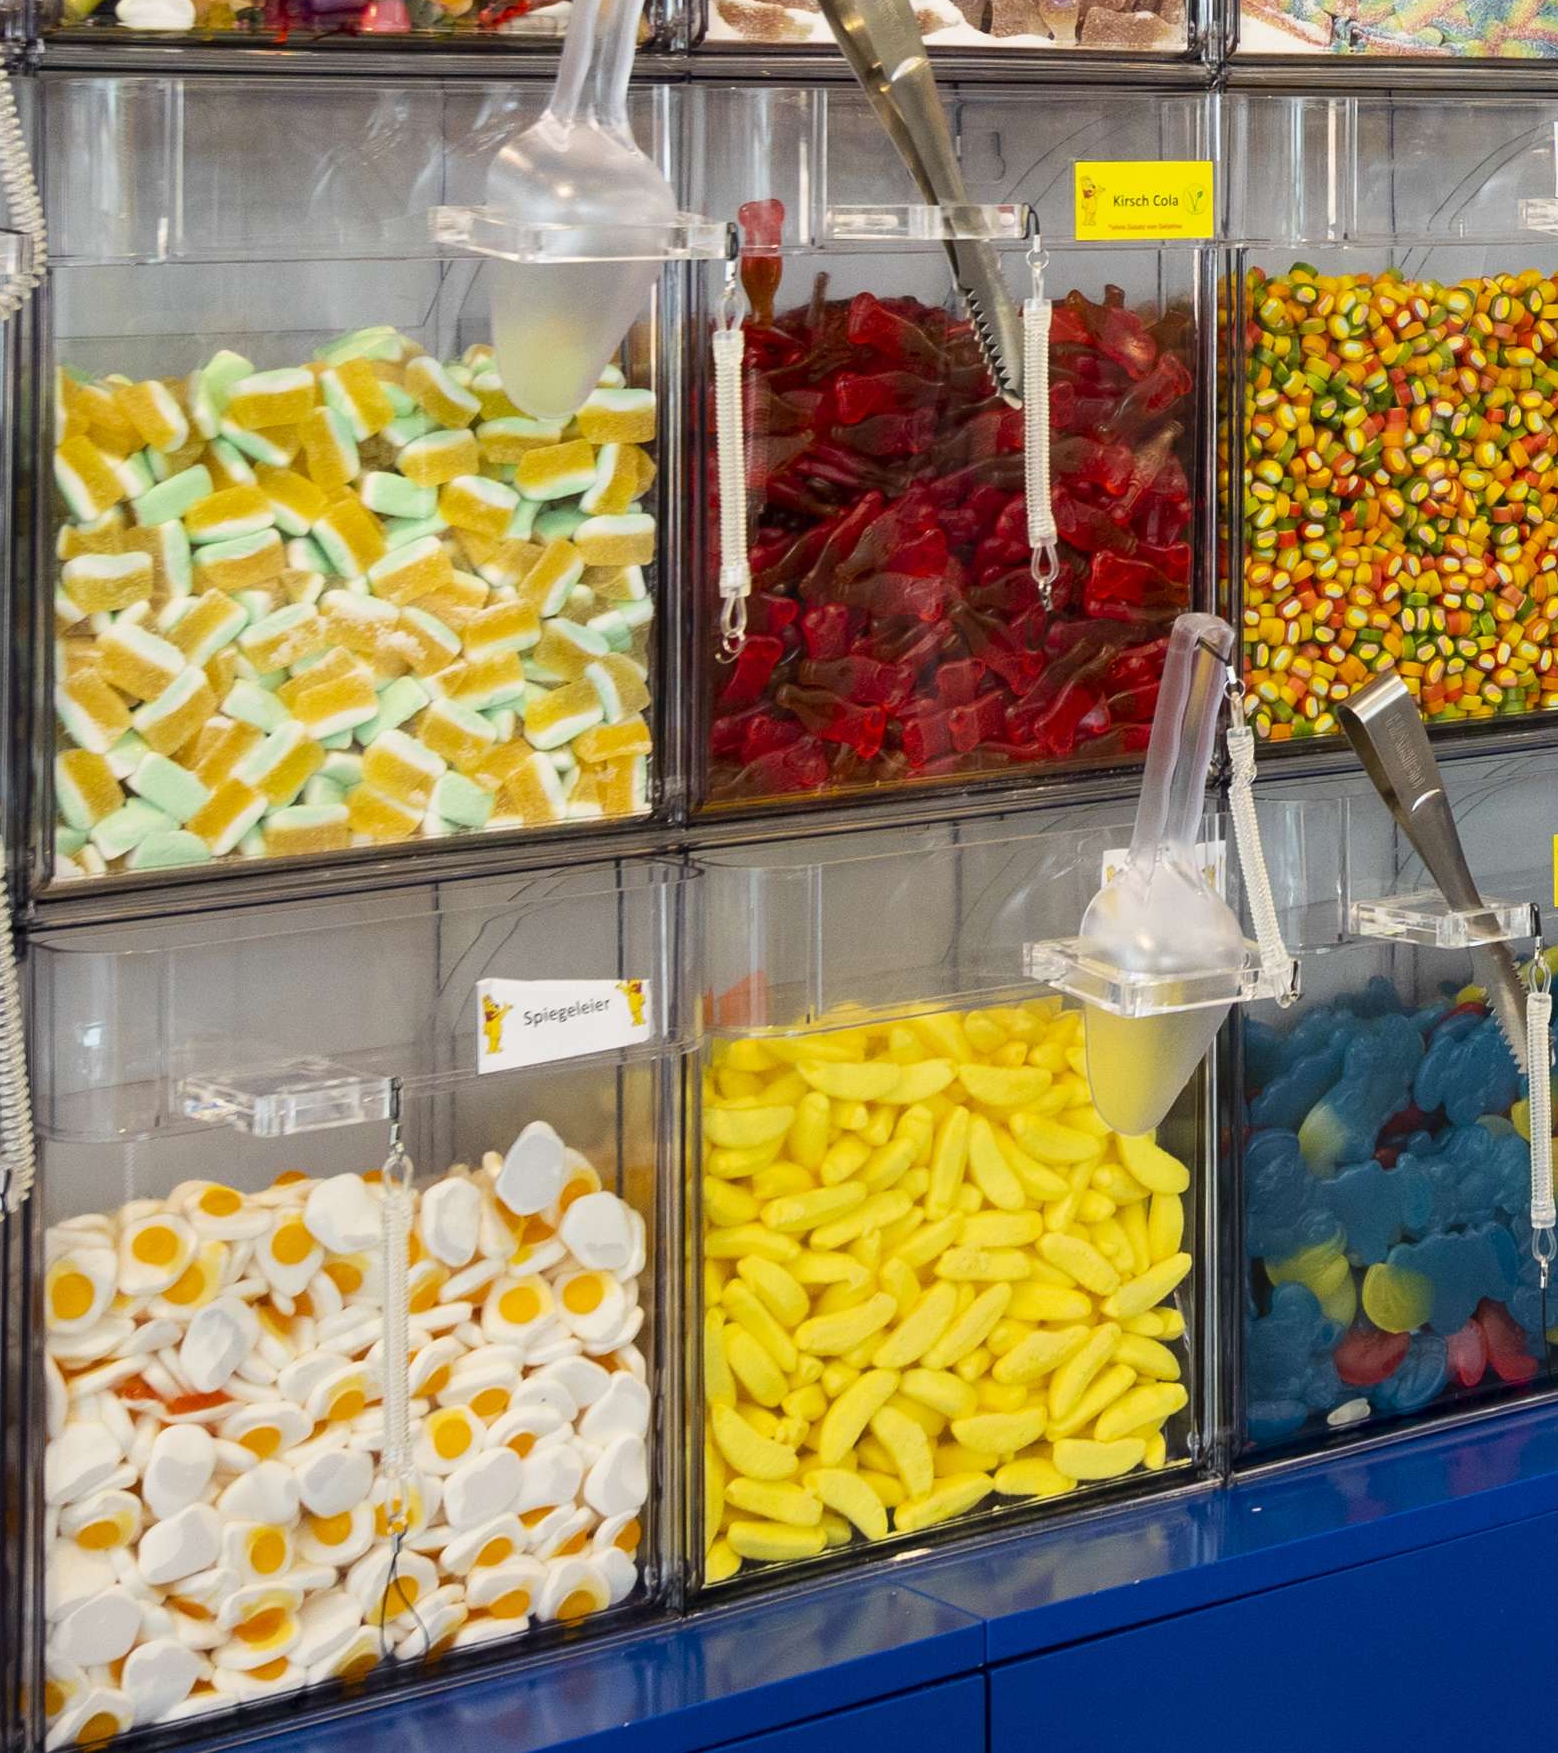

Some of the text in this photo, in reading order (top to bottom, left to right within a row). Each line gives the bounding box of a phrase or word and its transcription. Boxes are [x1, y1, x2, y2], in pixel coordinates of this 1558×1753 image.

[1113, 194, 1179, 207] Kirsch Cola
[523, 998, 610, 1028] Spiegeleier
